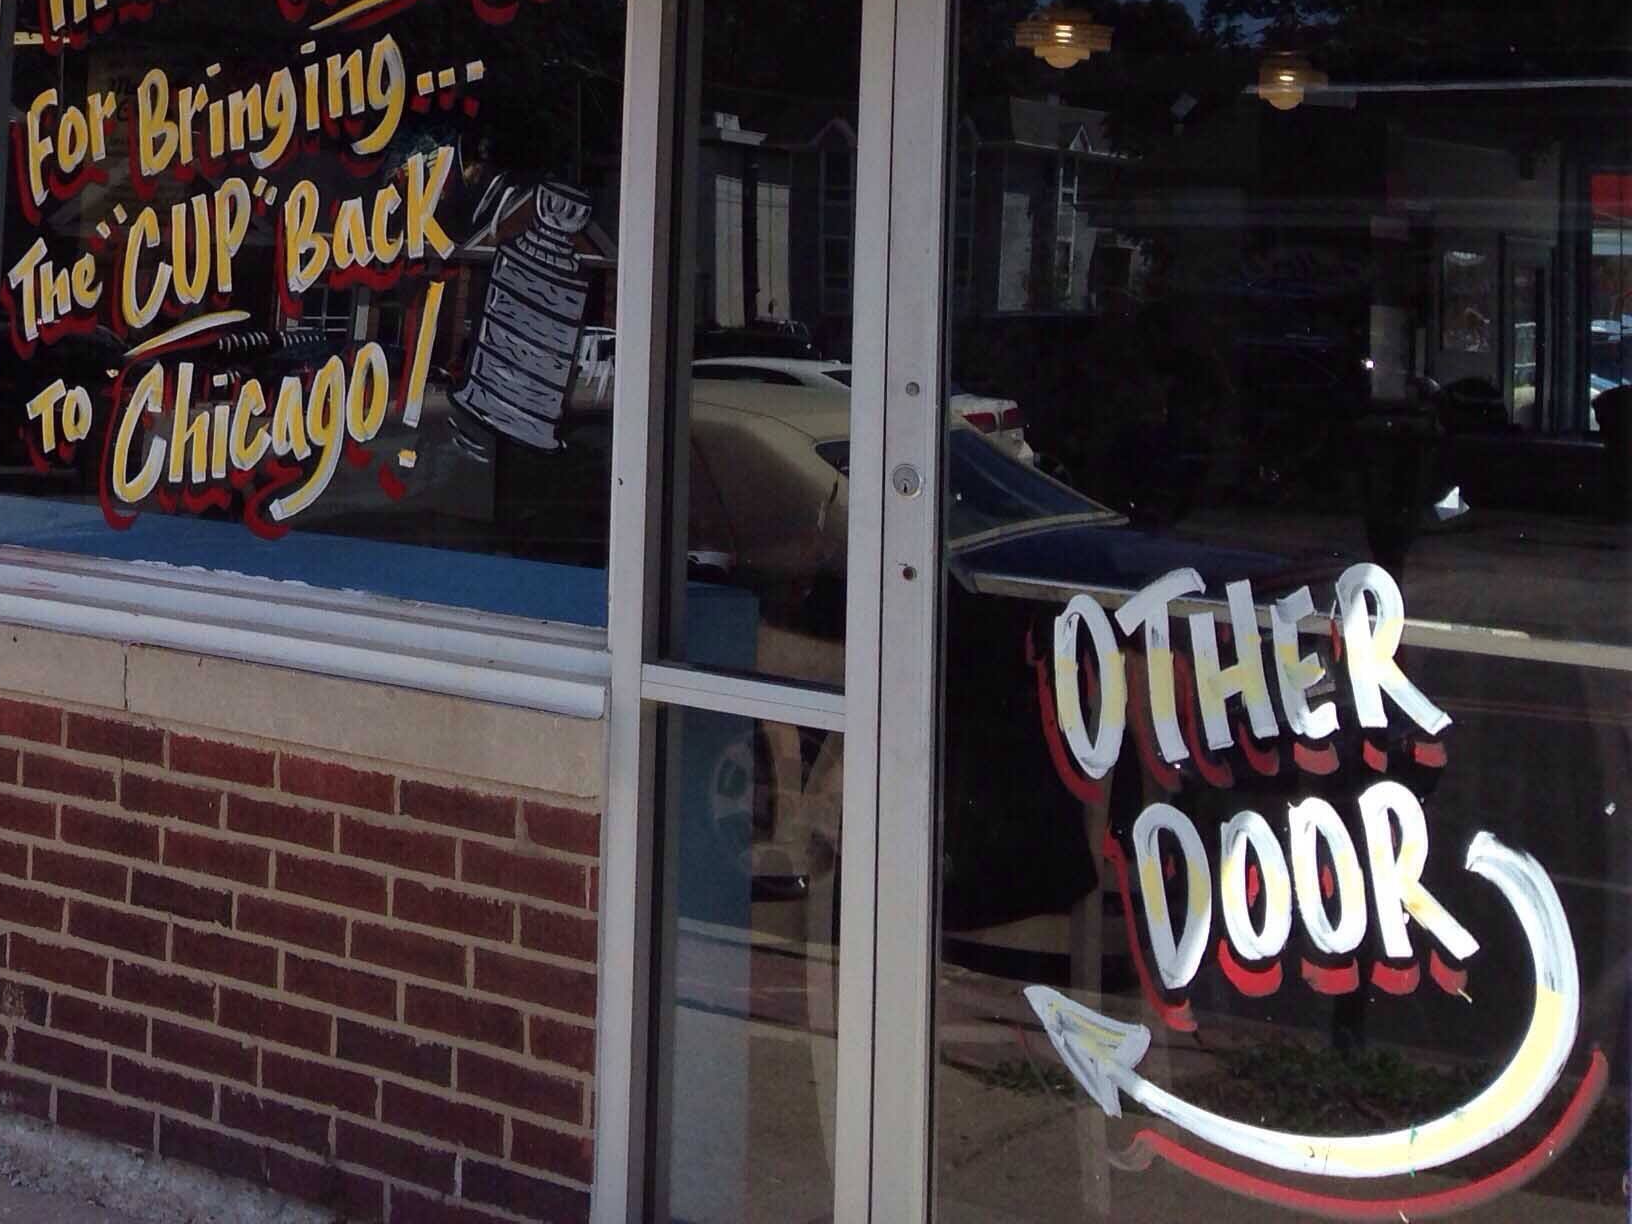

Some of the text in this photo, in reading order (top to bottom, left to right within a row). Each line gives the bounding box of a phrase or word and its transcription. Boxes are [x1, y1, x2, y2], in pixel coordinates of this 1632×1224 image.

[26, 88, 115, 206] For
[8, 236, 104, 342] The
[1054, 562, 1453, 779] OTHER
[1132, 781, 1480, 989] DOOR
